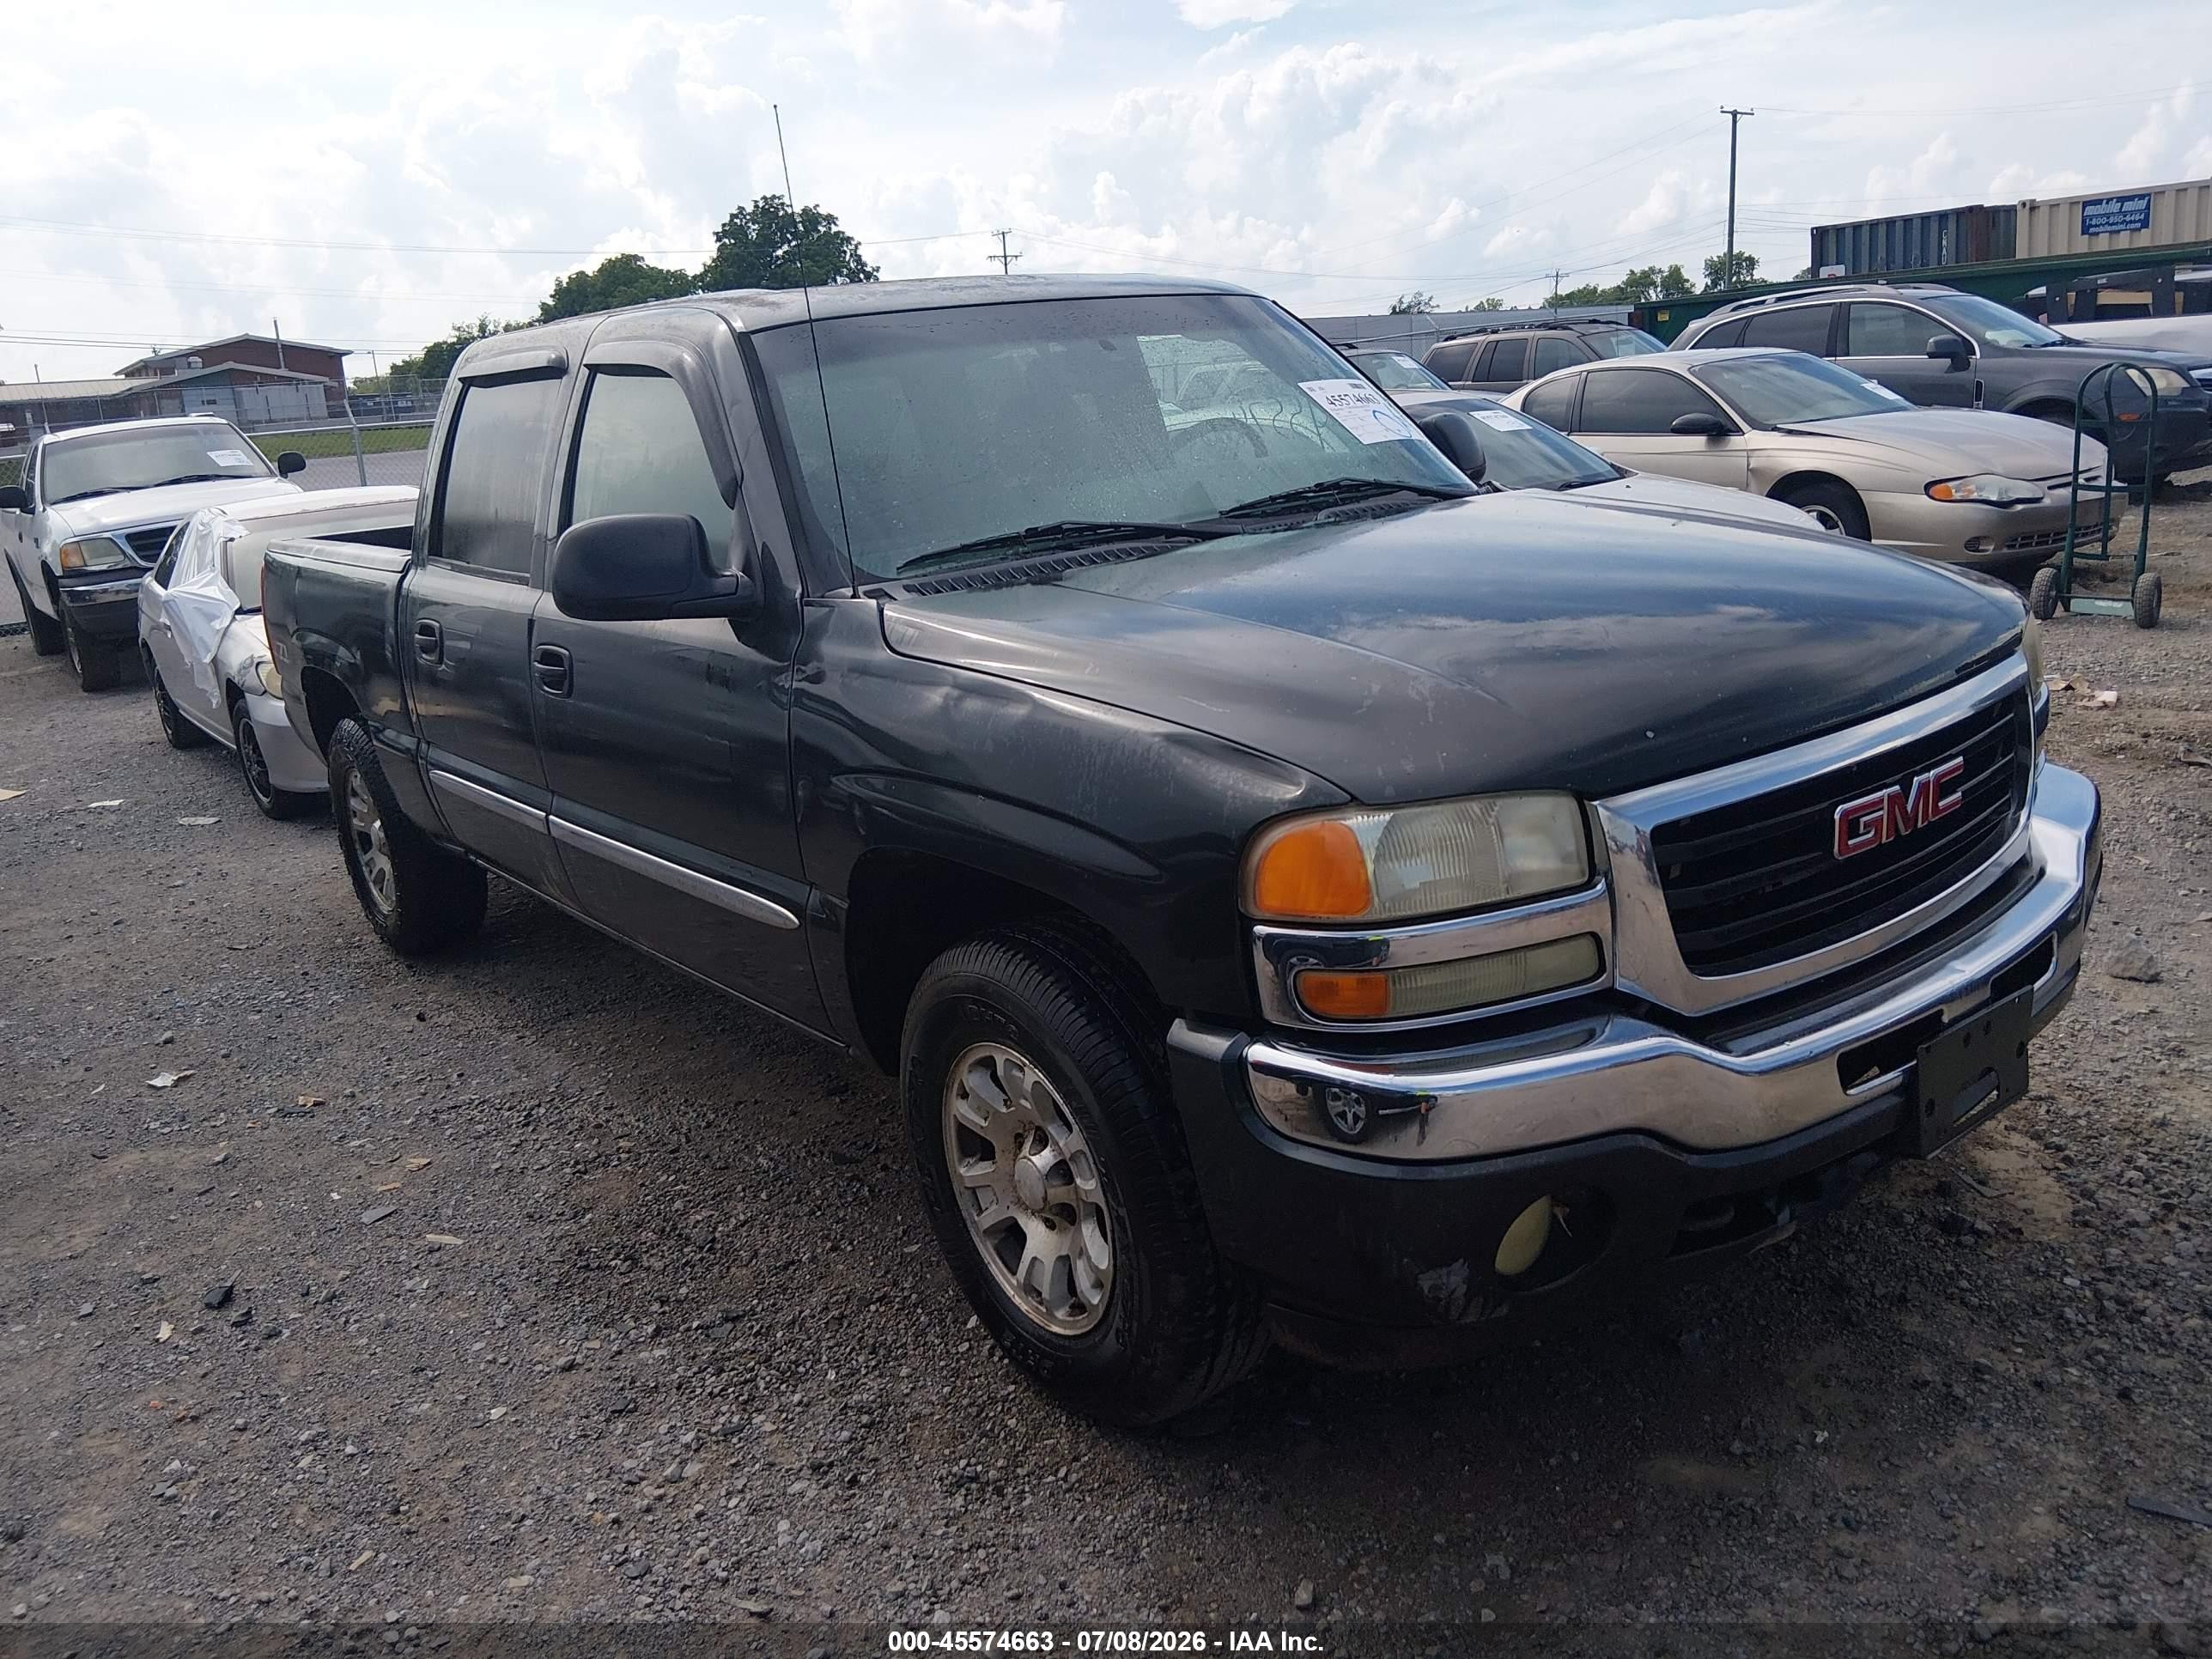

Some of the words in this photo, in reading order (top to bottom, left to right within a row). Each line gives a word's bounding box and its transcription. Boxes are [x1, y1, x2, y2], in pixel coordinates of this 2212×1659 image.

[2083, 198, 2122, 216] mobile
[2122, 196, 2150, 211] mini
[2086, 213, 2145, 226] 1-800-950-6464
[2089, 222, 2142, 234] mobilemini.com
[1325, 392, 1381, 407] 45574663
[1834, 756, 1965, 860] GMC
